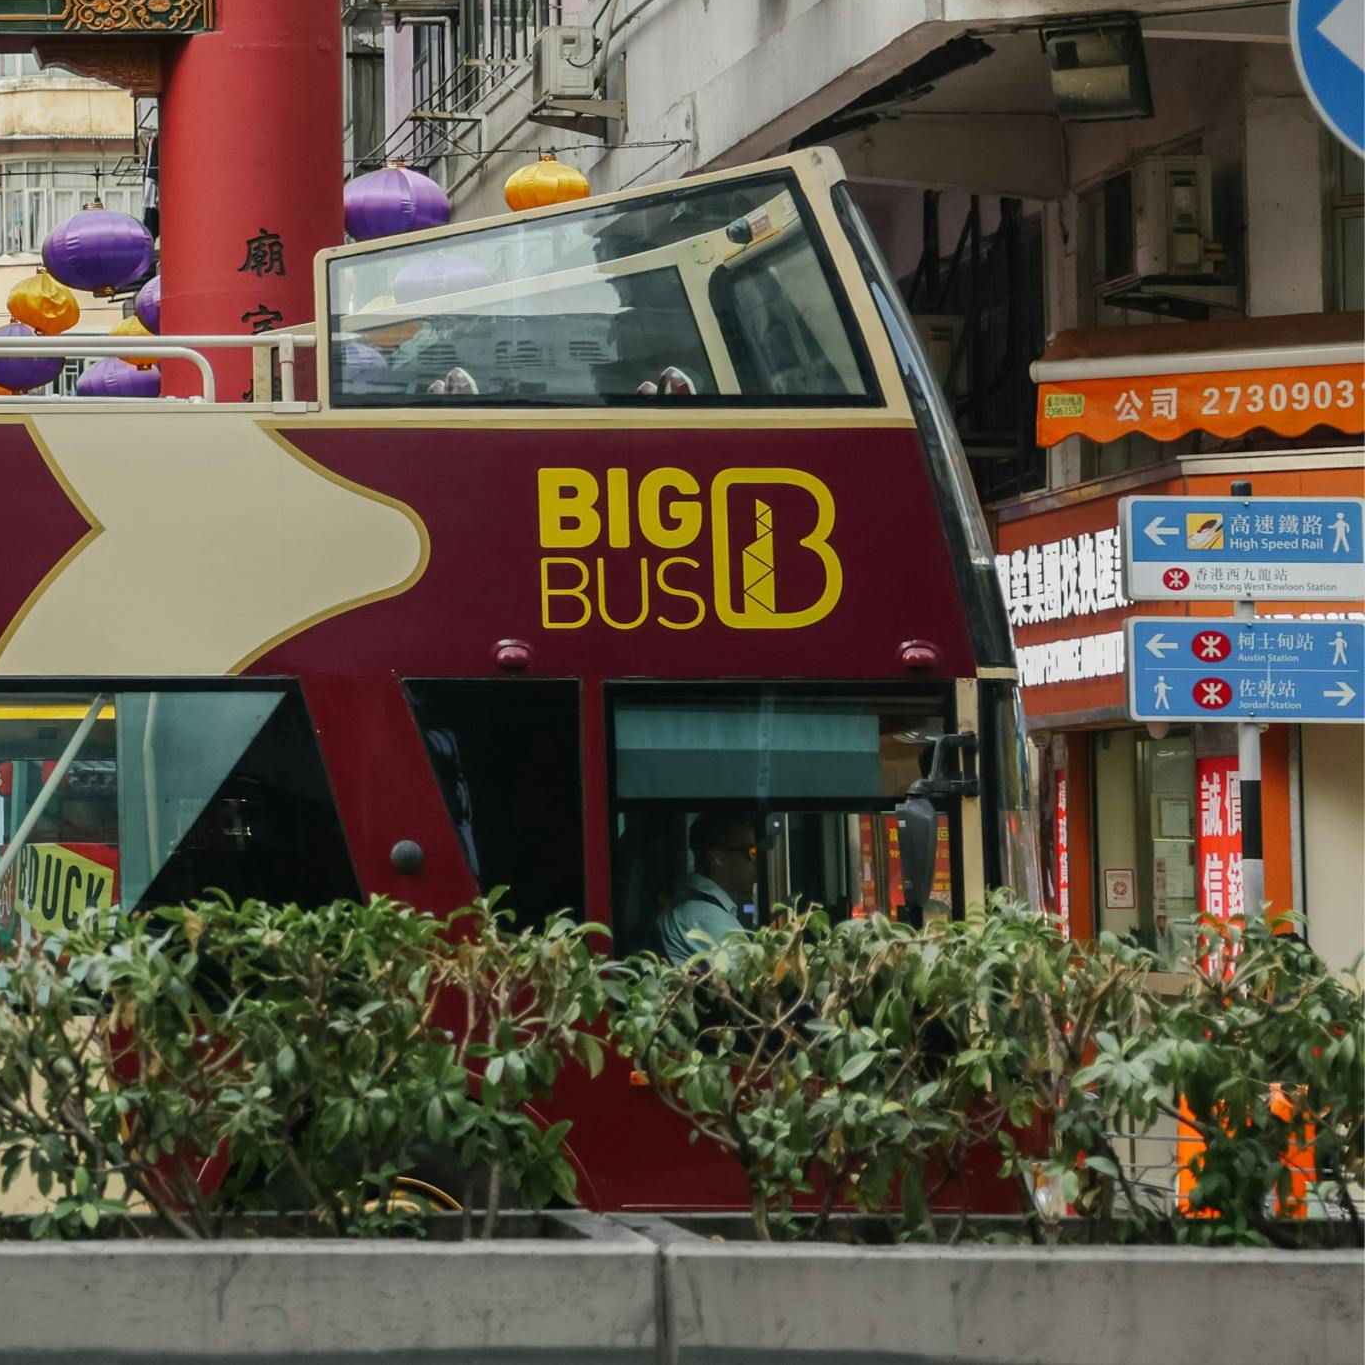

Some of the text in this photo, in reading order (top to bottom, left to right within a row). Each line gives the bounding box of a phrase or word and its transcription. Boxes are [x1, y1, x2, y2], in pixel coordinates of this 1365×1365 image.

[1201, 380, 1365, 415] 2730903
[537, 466, 704, 549] BIG
[1230, 514, 1323, 535] 高速鐵路
[1230, 537, 1324, 551] High Speed Rail
[1195, 567, 1288, 581] 香港西九龍站
[540, 556, 707, 630] BUS
[1194, 582, 1337, 593] Hong Kong West Kowloon Station
[1237, 632, 1314, 652] 柯士甸站
[1238, 653, 1299, 663] Austin Station
[1239, 679, 1296, 699] 佐敦站
[1239, 700, 1302, 710] Jordan Station
